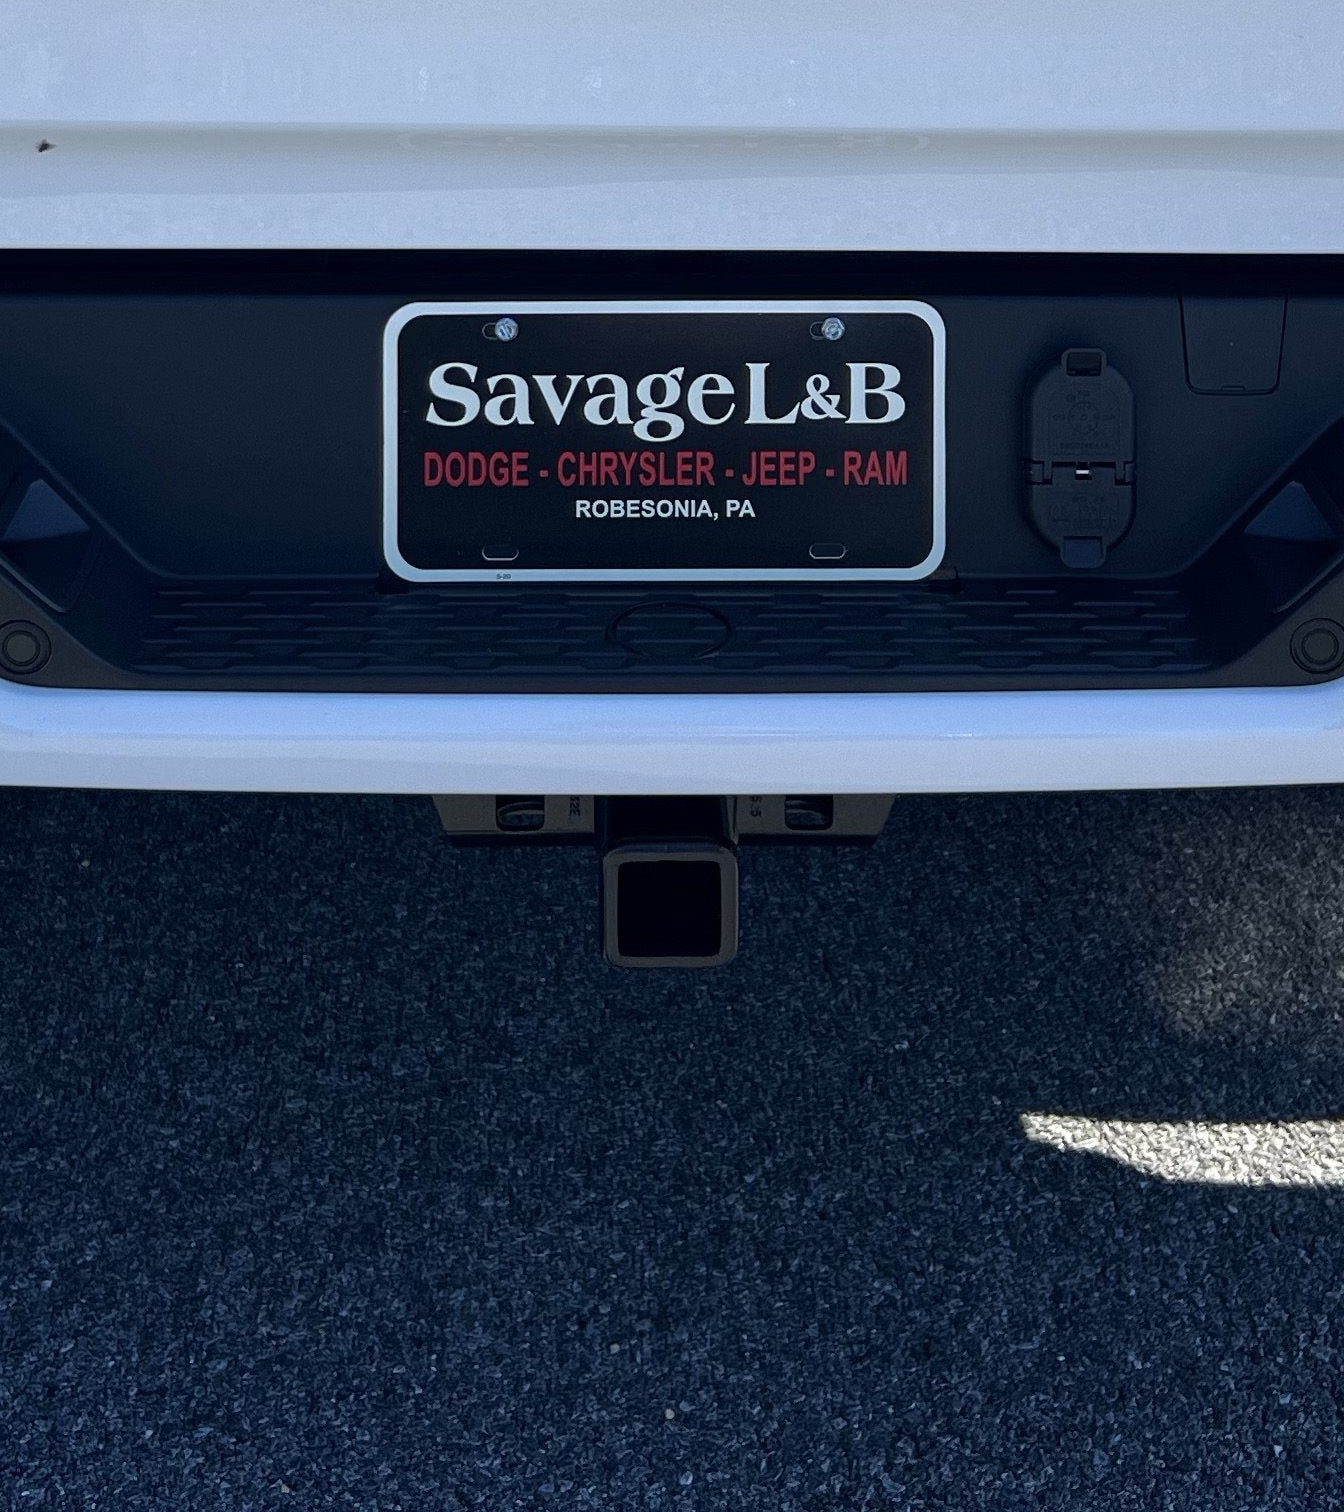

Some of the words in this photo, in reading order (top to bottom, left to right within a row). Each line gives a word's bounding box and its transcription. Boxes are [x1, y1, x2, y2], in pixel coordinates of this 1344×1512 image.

[423, 451, 529, 487] DODGE
[557, 451, 716, 487] CHRYSLER
[741, 451, 816, 486] JEEP
[842, 451, 908, 486] RAM
[574, 499, 719, 521] ROBESONIA,
[725, 499, 756, 519] PA
